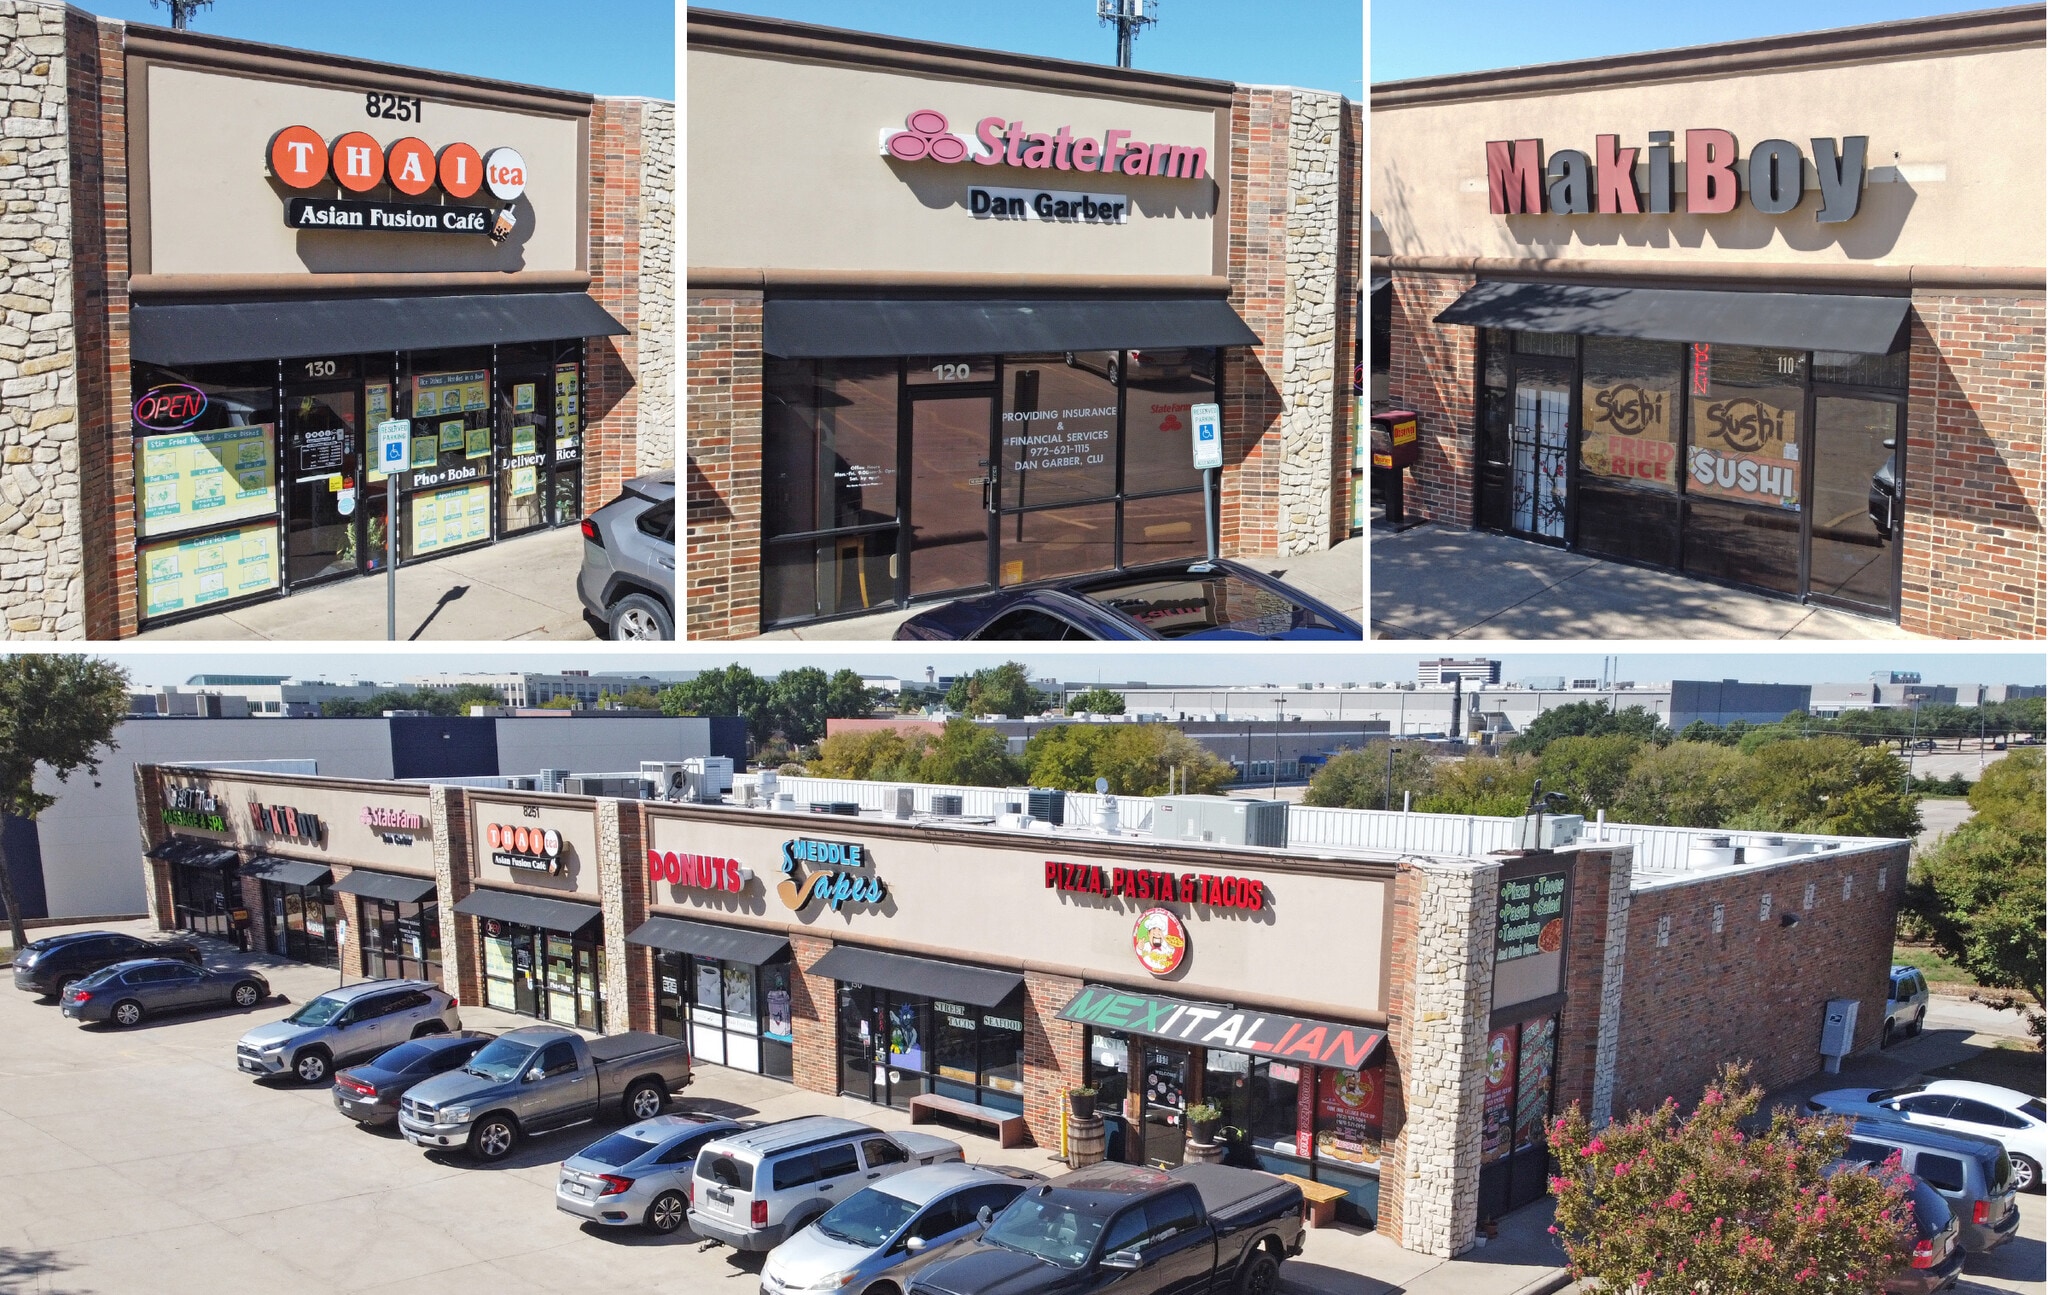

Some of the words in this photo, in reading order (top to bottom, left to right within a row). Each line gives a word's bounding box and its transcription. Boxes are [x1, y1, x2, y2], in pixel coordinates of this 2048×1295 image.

[366, 91, 421, 123] 8251
[288, 141, 467, 185] THAI
[489, 164, 524, 186] tea
[971, 189, 1025, 217] Dan
[1034, 193, 1125, 222] Garber
[299, 205, 363, 226] Asian
[370, 208, 437, 228] Fusion
[442, 212, 485, 231] Café
[305, 360, 336, 378] 130
[931, 363, 970, 381] 120
[1777, 357, 1794, 374] 110
[139, 394, 201, 420] OPEN
[1002, 409, 1059, 422] PROVIDING
[1062, 406, 1117, 418] INSURANCE
[1595, 387, 1662, 430] Sushi
[380, 425, 408, 434] RESERVED
[1056, 421, 1064, 430] &
[1706, 400, 1784, 443] Sushi
[150, 439, 165, 449] Stir
[168, 438, 187, 447] Fried
[223, 432, 237, 440] Rice
[382, 433, 406, 441] PARKING
[1010, 434, 1063, 446] FINANCIAL
[1067, 430, 1109, 442] SERVICES
[555, 448, 577, 461] Rice
[1030, 443, 1090, 457] 972-621-1115
[1608, 434, 1675, 463] FRIED
[502, 453, 546, 470] Delivery
[1014, 461, 1038, 471] DAN
[1042, 456, 1083, 469] GARBER,
[1087, 454, 1104, 464] CLU
[1611, 456, 1667, 481] RICE
[413, 473, 438, 487] Pho
[447, 466, 476, 480] Boba
[1693, 452, 1794, 498] SUSHI
[193, 535, 226, 547] Curries
[161, 808, 199, 828] MASSAGE
[207, 814, 225, 832] SPA
[522, 805, 540, 818] 8251
[490, 829, 540, 849] THAI
[545, 839, 558, 849] tea
[494, 855, 511, 866] Asian
[511, 857, 532, 868] Fusion
[532, 860, 547, 871] Café
[782, 838, 862, 873] SMEDDLE
[649, 849, 741, 893] DONUTS
[1044, 860, 1110, 898] PIZZA,
[1112, 867, 1175, 902] PASTA
[1180, 873, 1195, 903] &
[1199, 873, 1263, 912] TACOS
[1505, 881, 1530, 901] Pizza
[1538, 876, 1565, 896] Tacos
[1504, 902, 1530, 923] Pasta
[1536, 894, 1562, 916] Salad
[934, 1001, 965, 1016] STREET
[947, 1015, 976, 1031] TACOS
[983, 1015, 1023, 1033] SEAFOOD
[1064, 989, 1379, 1067] MEXITALIAN
[1094, 1036, 1127, 1051] PASTA
[1154, 1069, 1177, 1079] WELCOME
[1206, 1060, 1248, 1074] SALADS
